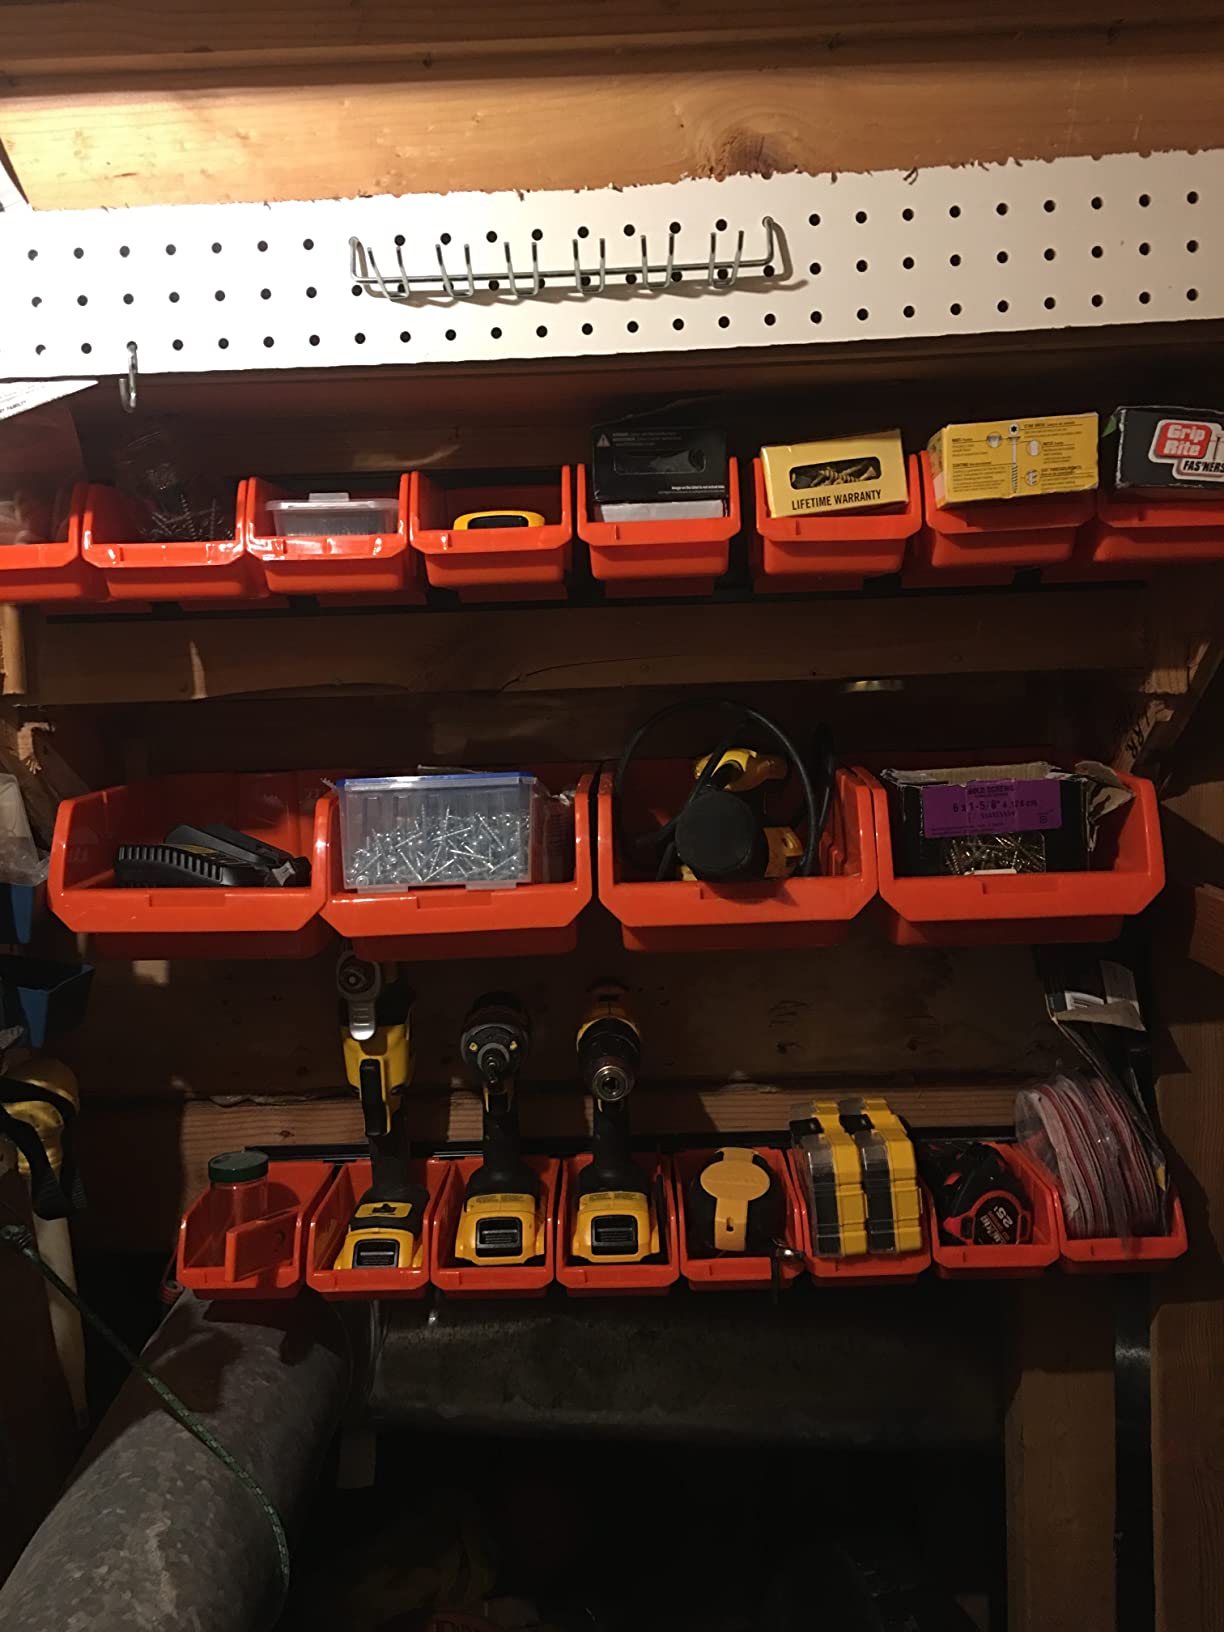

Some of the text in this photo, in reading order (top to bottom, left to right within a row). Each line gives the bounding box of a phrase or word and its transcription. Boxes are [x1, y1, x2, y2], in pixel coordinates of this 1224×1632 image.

[1167, 424, 1206, 443] Grip
[1163, 440, 1201, 456] Rite
[791, 489, 882, 511] LIFETIME WARRANTY
